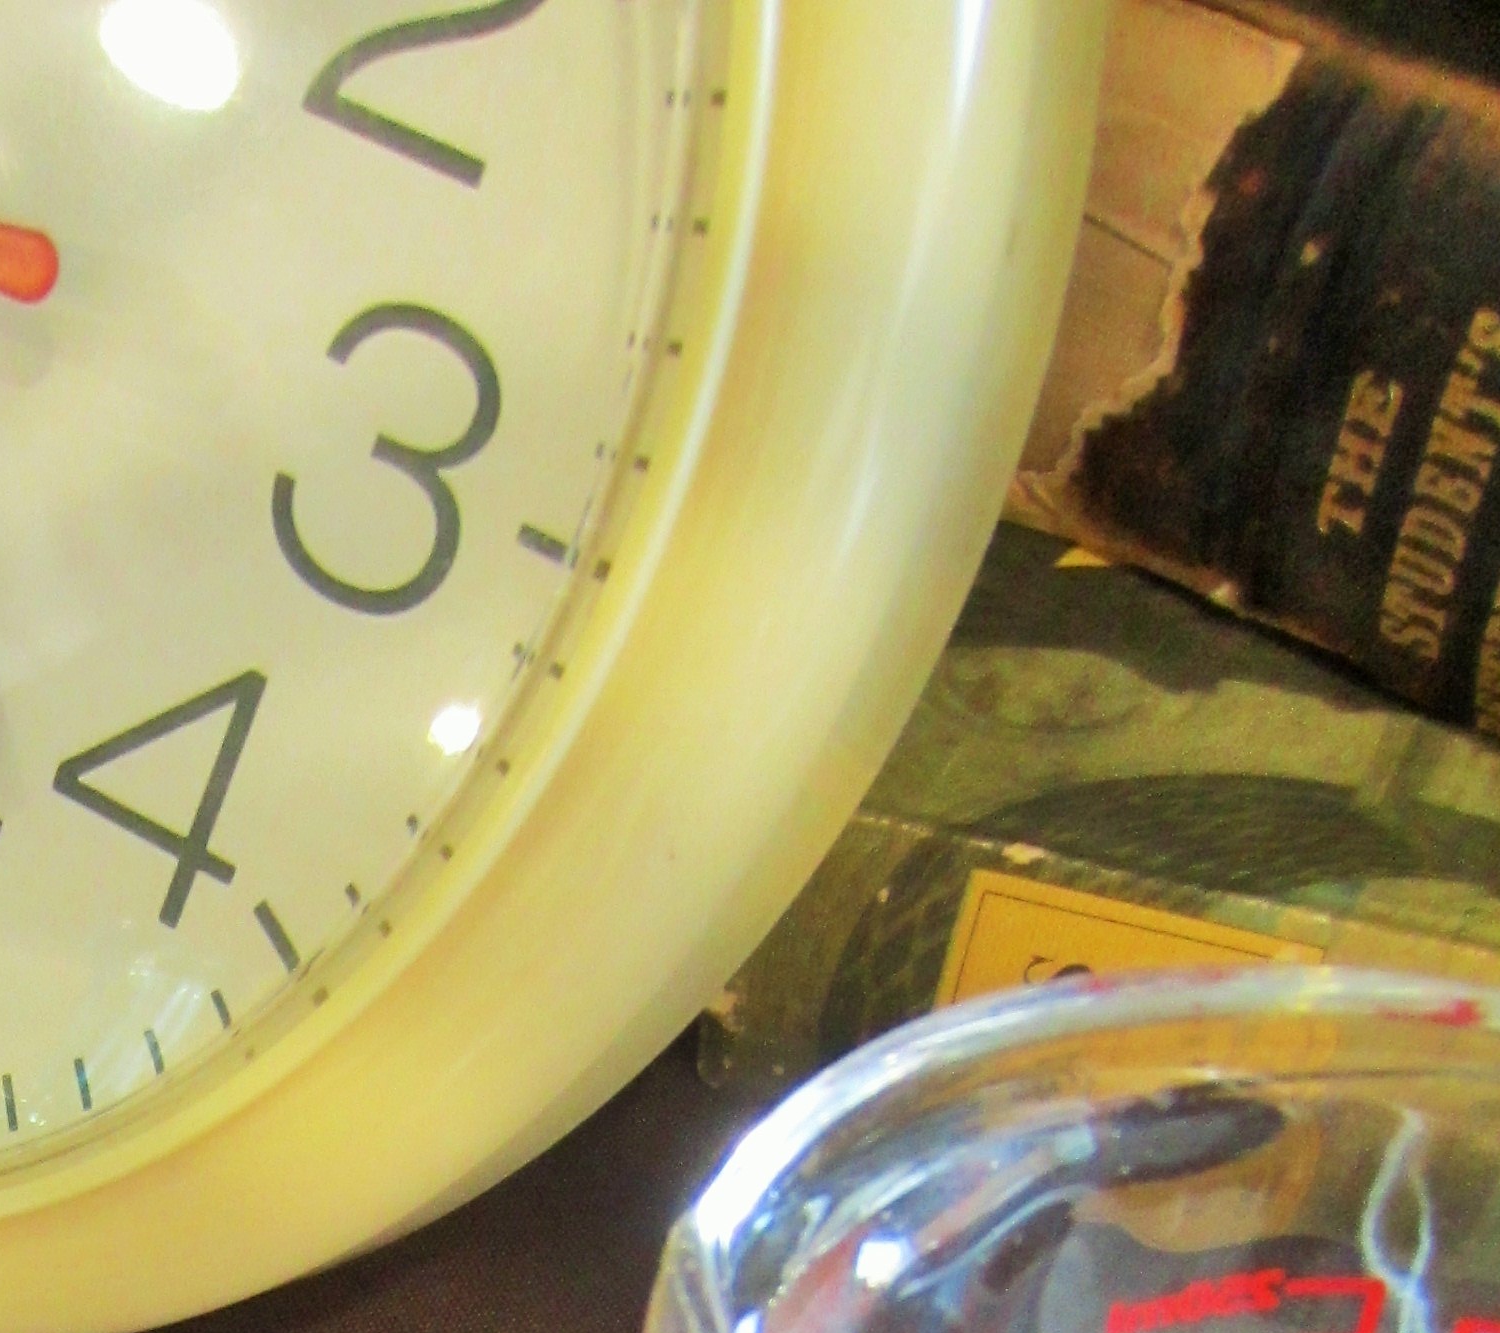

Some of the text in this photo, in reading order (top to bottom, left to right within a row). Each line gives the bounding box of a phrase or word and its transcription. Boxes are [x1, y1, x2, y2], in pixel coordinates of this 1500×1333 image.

[271, 302, 501, 616] 3
[1316, 370, 1402, 536] THE
[52, 669, 268, 929] 4
